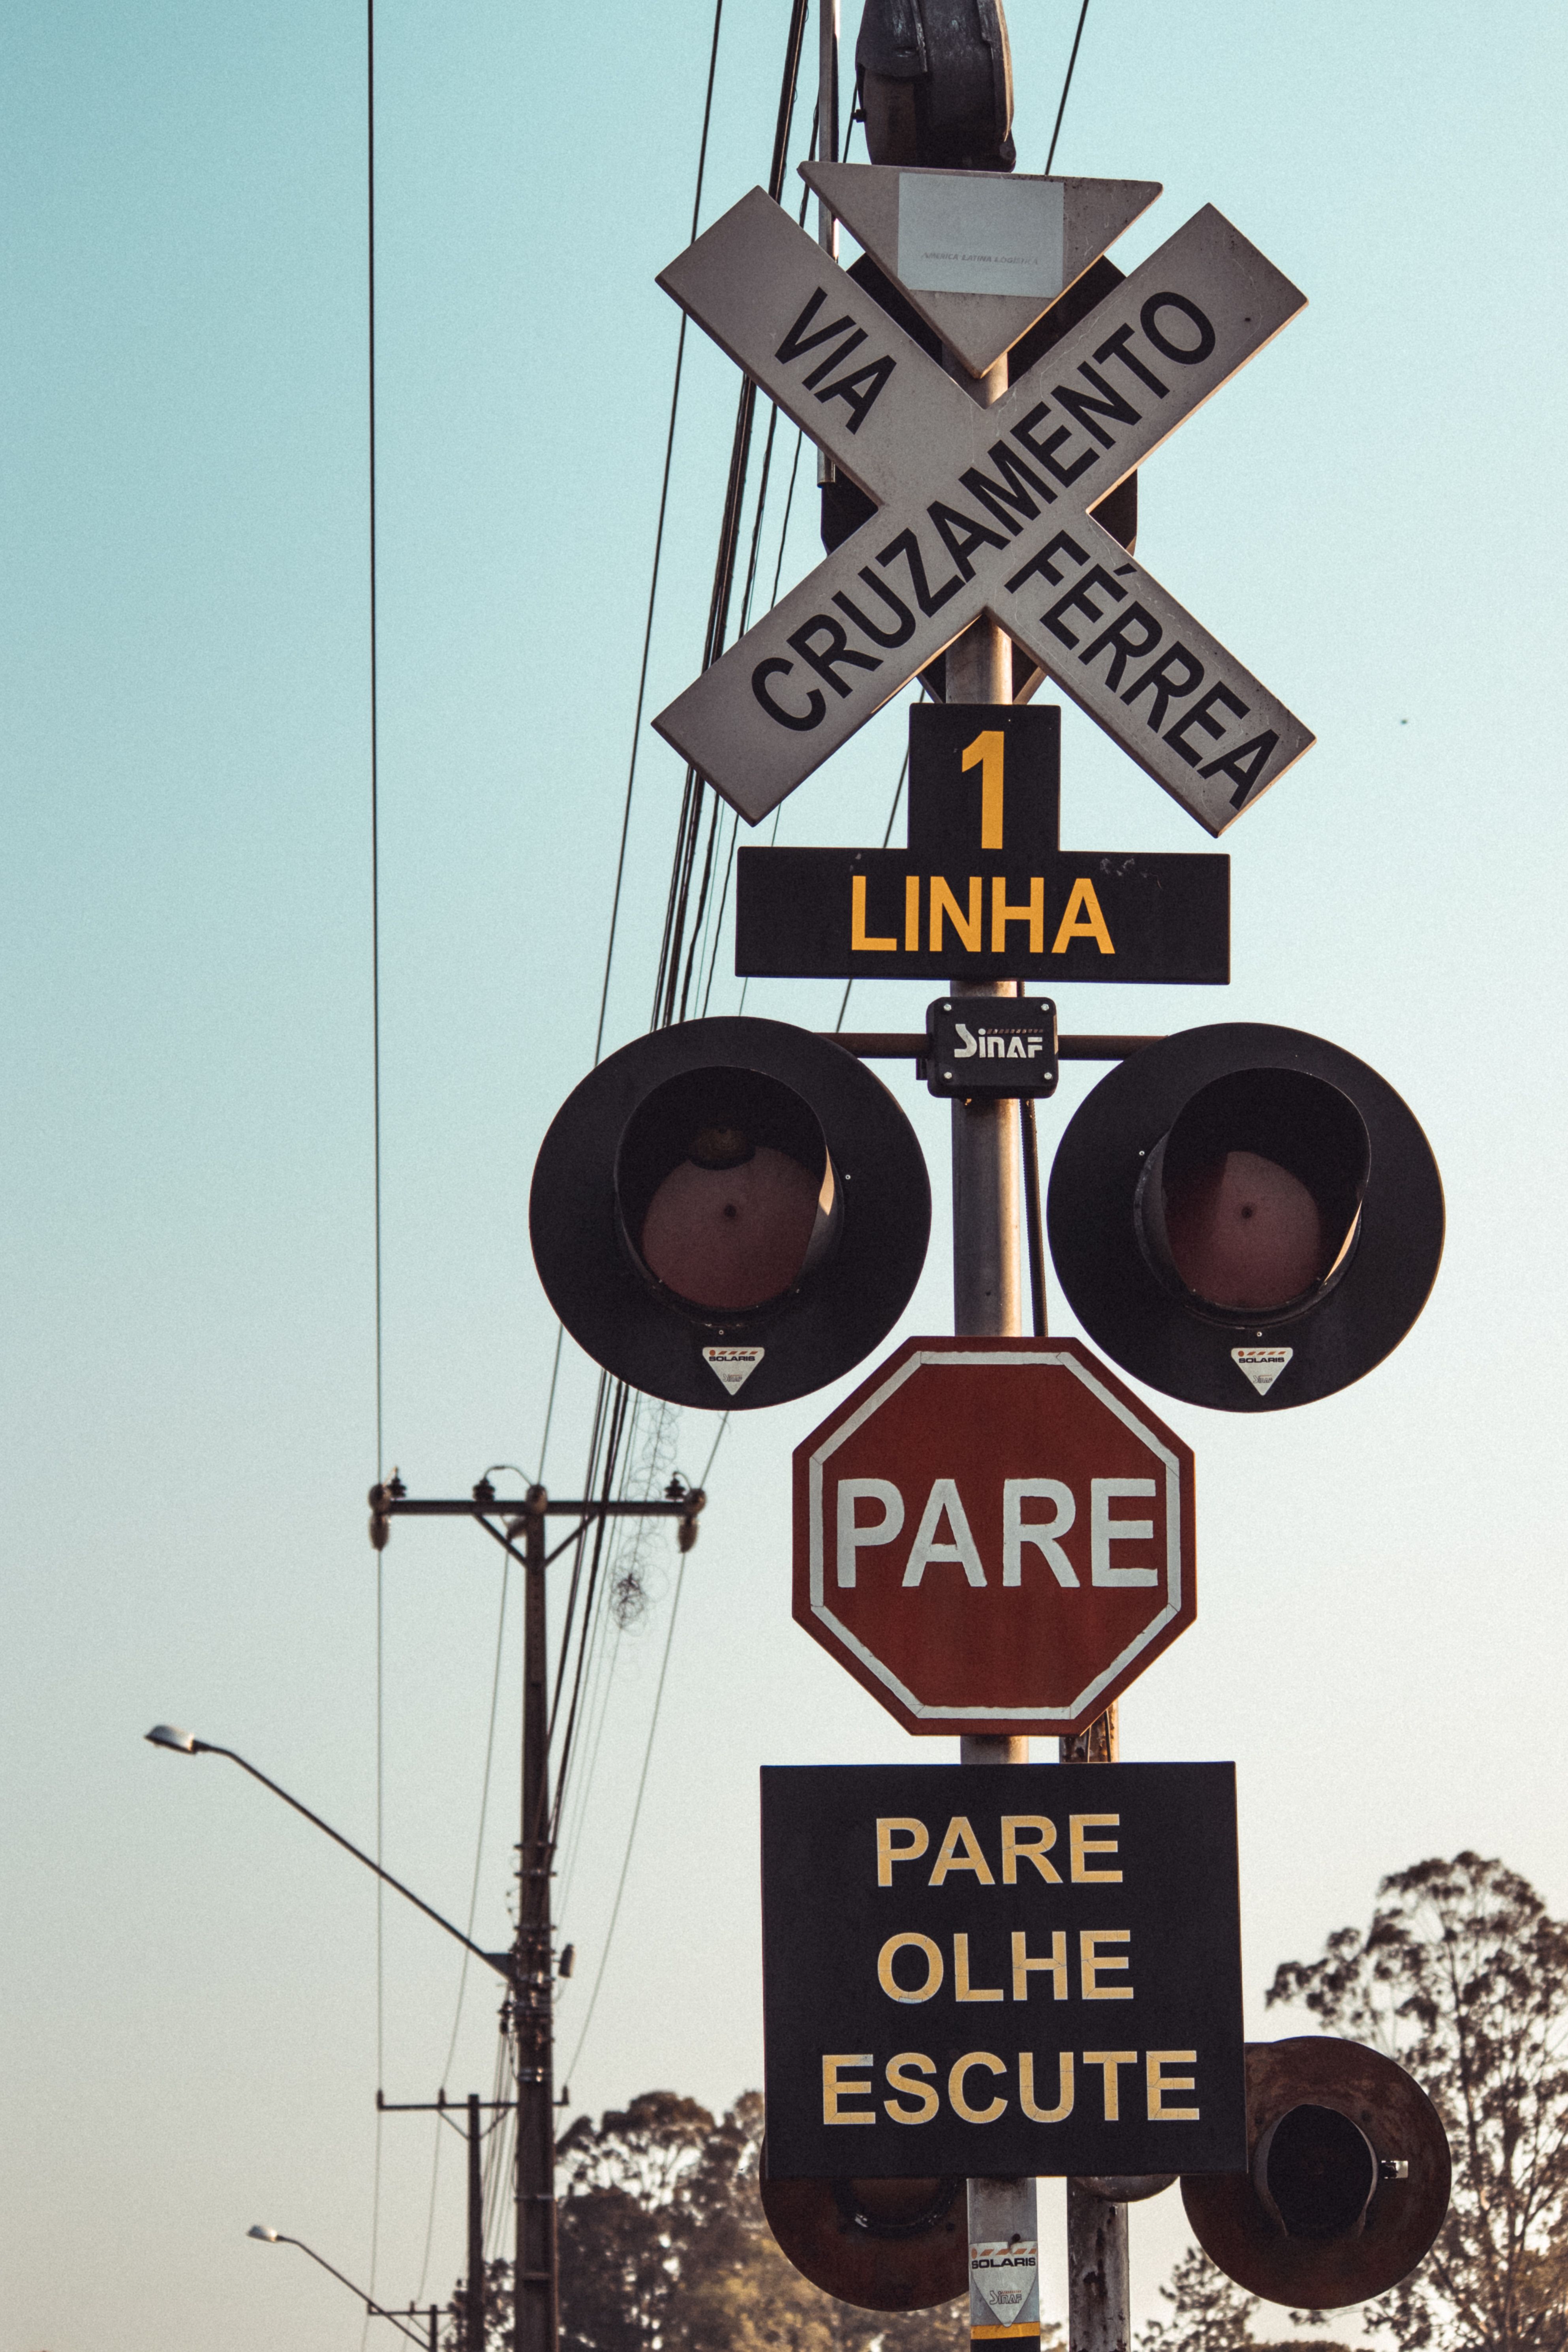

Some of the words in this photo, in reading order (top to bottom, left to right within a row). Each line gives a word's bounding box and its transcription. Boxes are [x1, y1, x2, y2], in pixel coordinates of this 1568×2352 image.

[961, 254, 992, 262] LATINA
[774, 287, 898, 434] VIA
[751, 291, 1216, 732] CRUZAMENTO
[1004, 530, 1281, 811] FÉRREA
[962, 730, 1004, 849] 1
[851, 876, 1115, 954] LINHA
[837, 1478, 1159, 1588] PARE
[876, 1813, 1123, 1887] PARE
[877, 1930, 1134, 2003] OLHE
[822, 2050, 1200, 2125] ESCUTE
[971, 2257, 1036, 2269] SOLARIS
